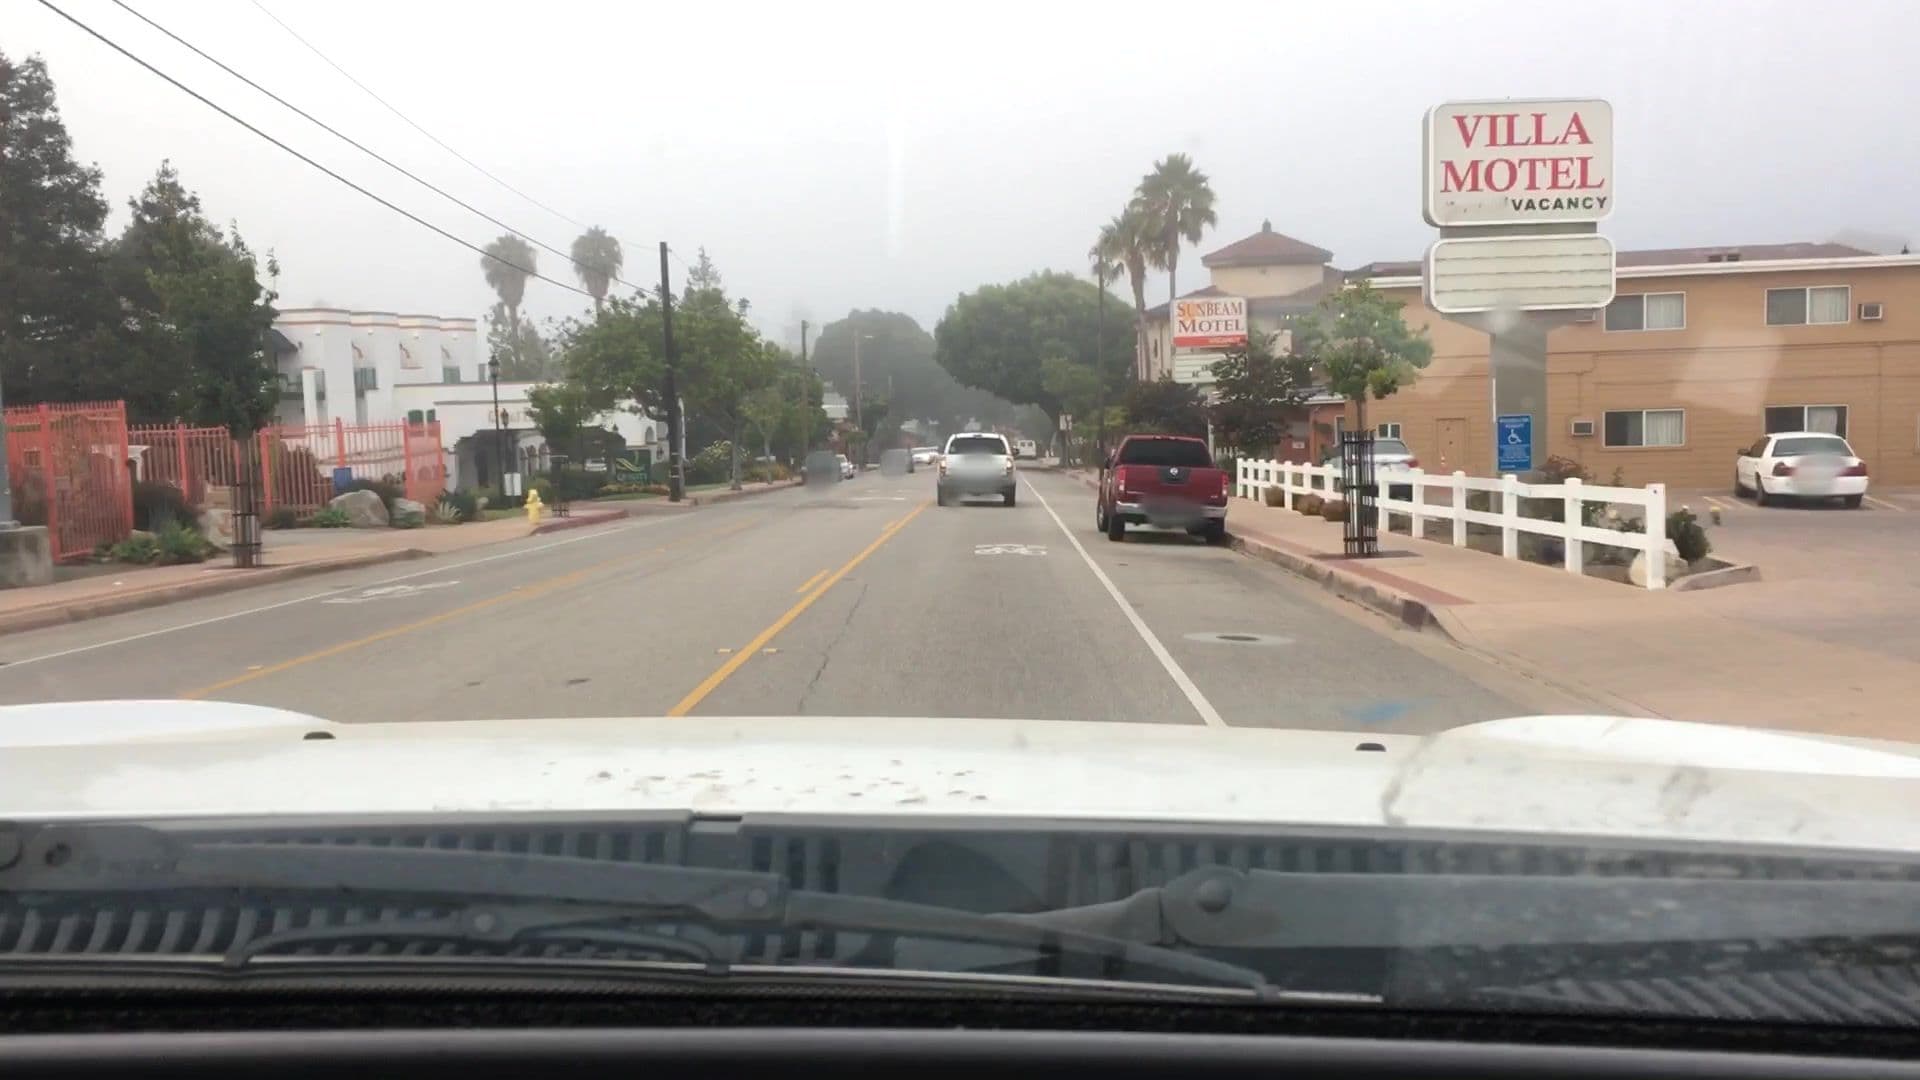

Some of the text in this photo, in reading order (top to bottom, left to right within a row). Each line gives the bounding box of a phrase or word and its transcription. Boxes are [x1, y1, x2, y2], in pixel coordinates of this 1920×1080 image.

[1452, 112, 1593, 149] VILLA
[1440, 155, 1605, 193] MOTEL
[1511, 196, 1608, 211] VACANCY
[1177, 301, 1243, 317] SUNBEAM
[1178, 319, 1246, 333] MOTEL
